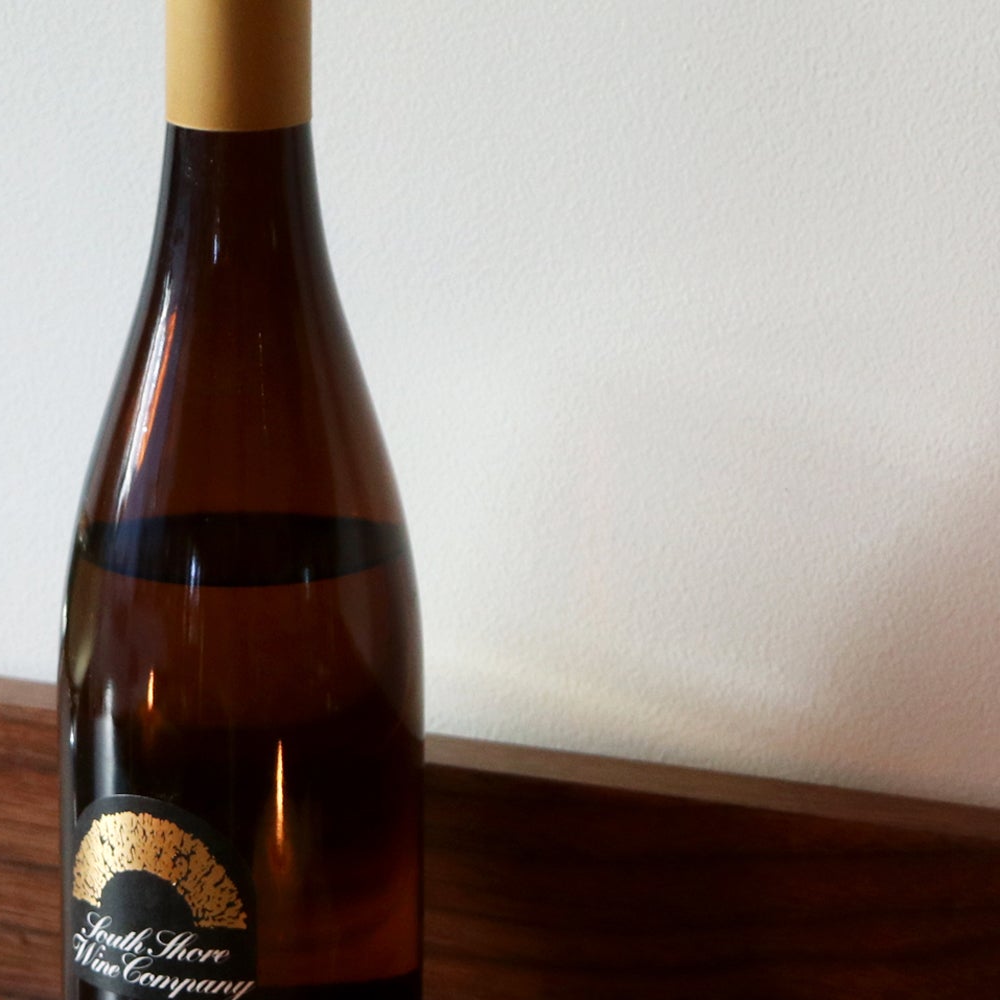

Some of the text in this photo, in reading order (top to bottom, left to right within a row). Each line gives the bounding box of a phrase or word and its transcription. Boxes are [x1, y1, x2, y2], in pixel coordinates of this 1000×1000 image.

[72, 932, 121, 978] Wine
[81, 911, 231, 964] South Shore
